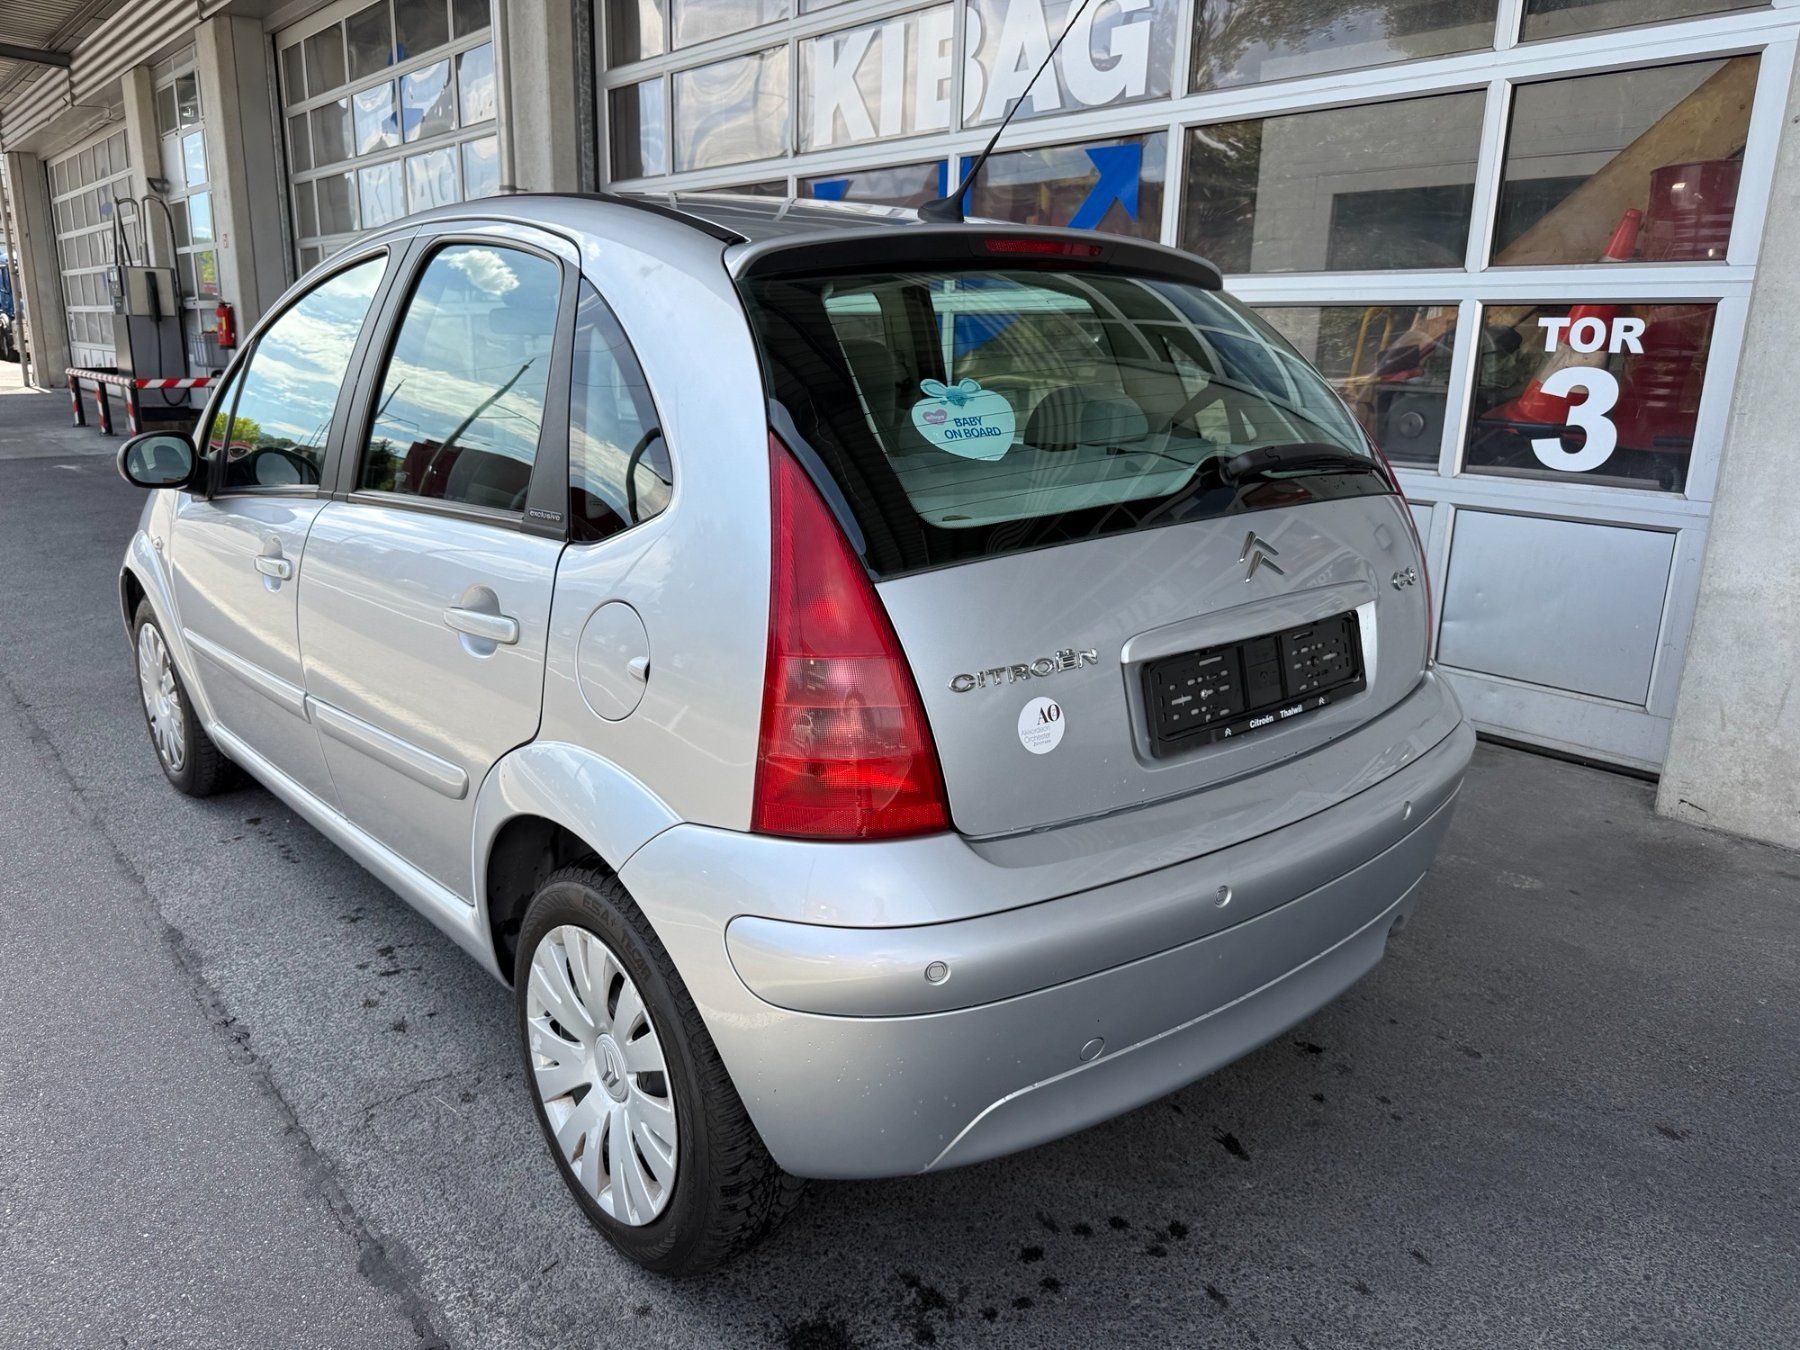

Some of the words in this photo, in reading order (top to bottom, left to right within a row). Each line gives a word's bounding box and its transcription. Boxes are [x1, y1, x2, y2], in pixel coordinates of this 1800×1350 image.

[813, 0, 1151, 147] KIBAG
[1537, 316, 1645, 354] TOR
[944, 429, 963, 440] ON
[963, 426, 1002, 438] BOARD
[954, 416, 983, 428] BABY
[1530, 366, 1619, 473] 3
[948, 648, 1099, 693] CITROËN
[1280, 705, 1303, 718] Thalwil
